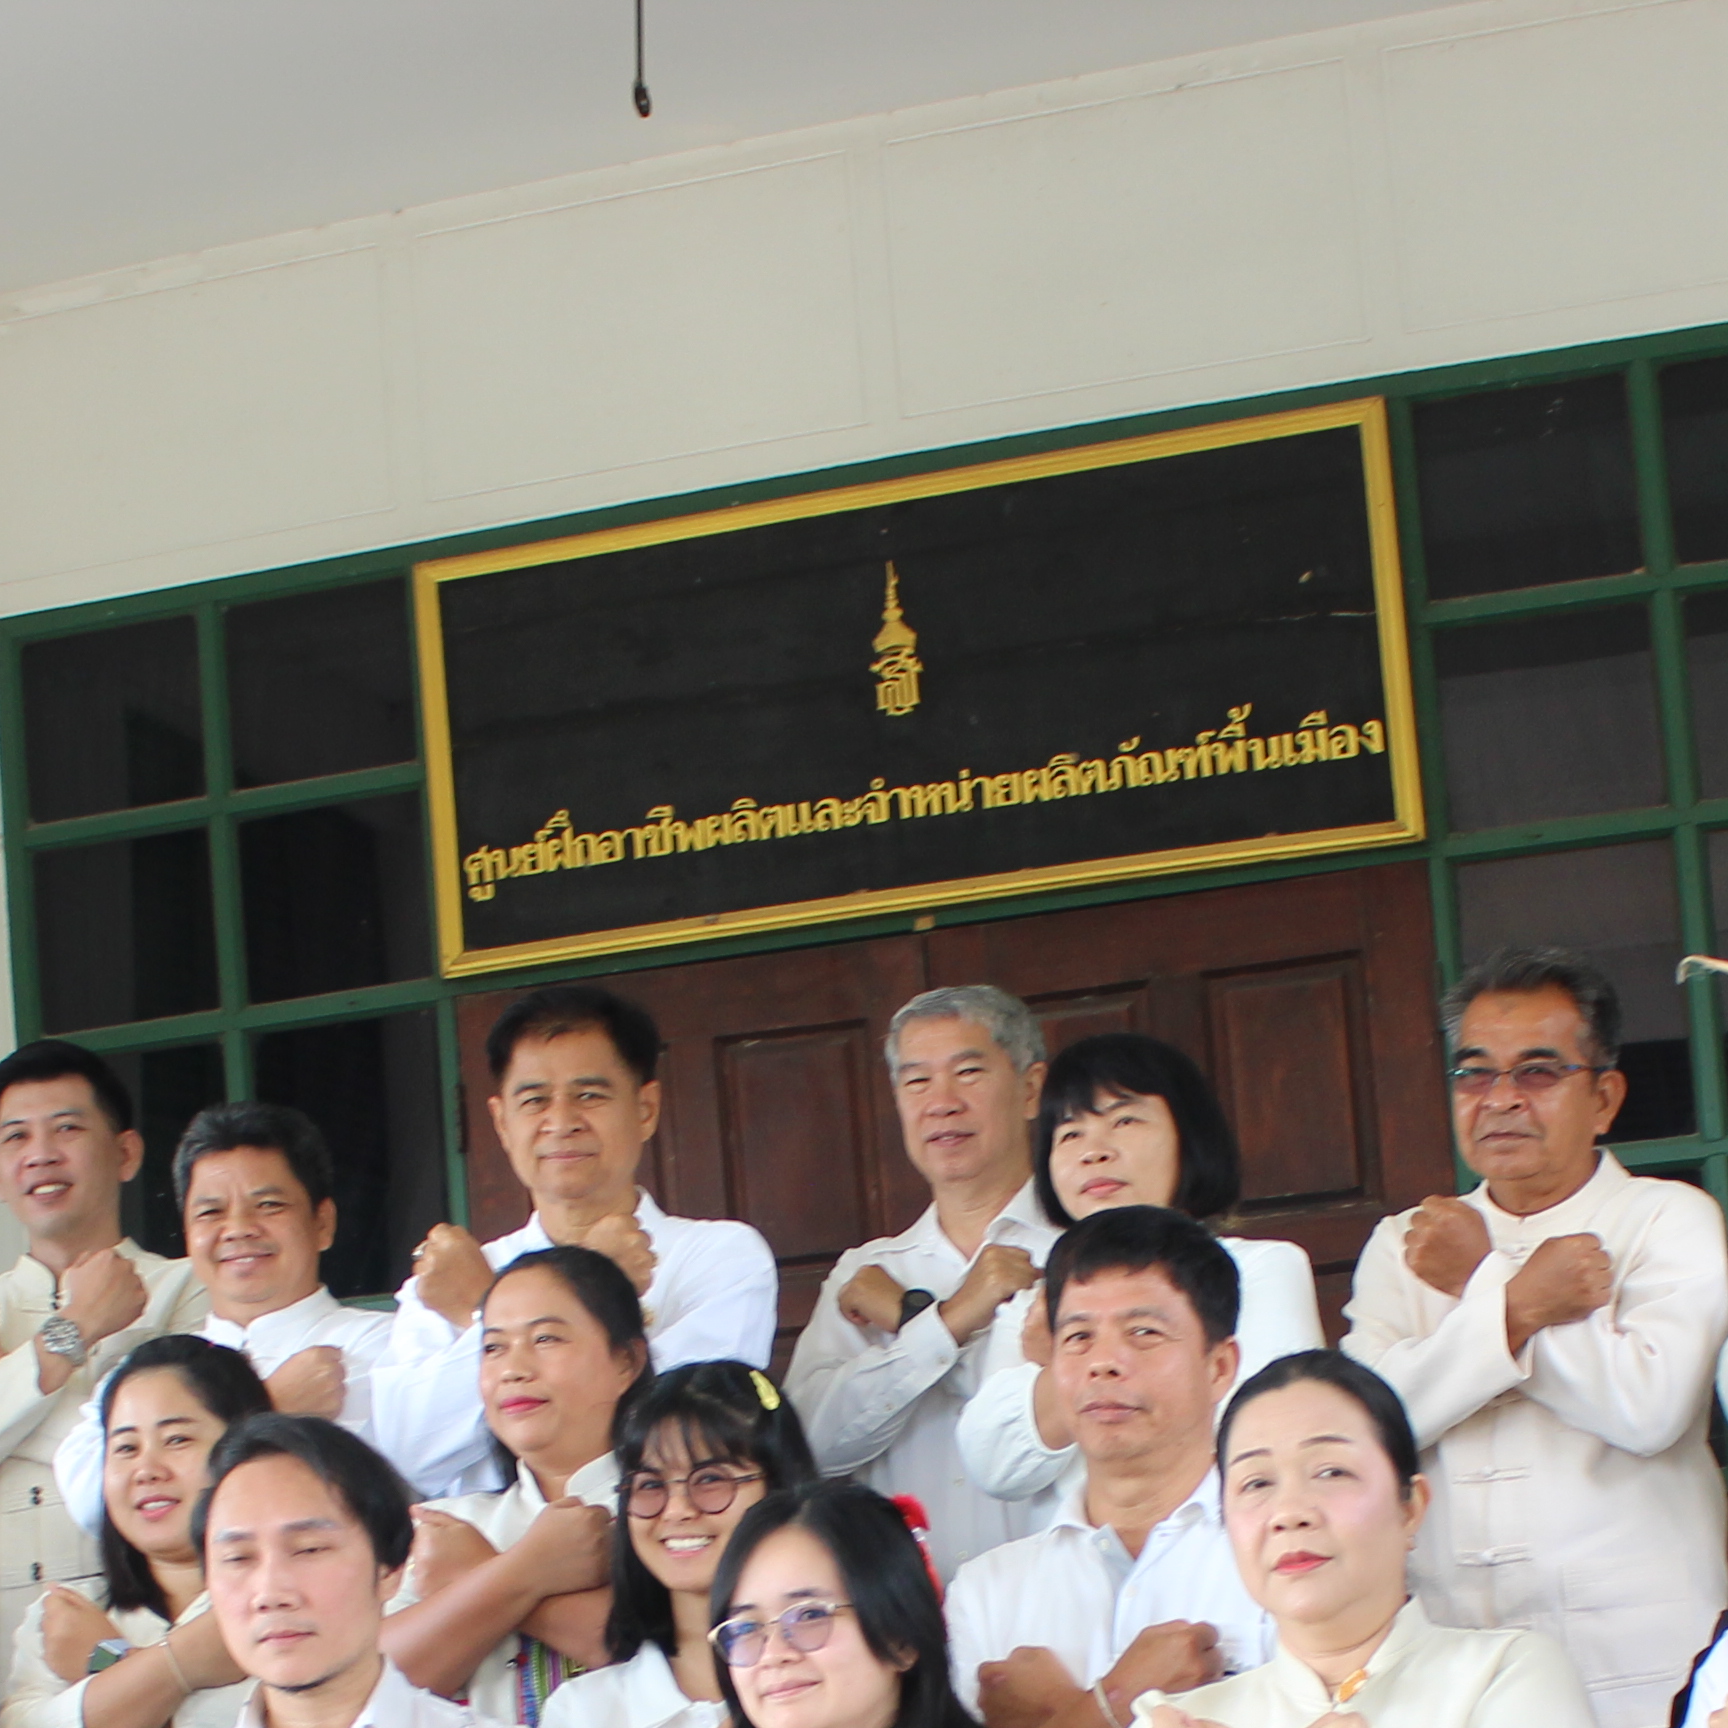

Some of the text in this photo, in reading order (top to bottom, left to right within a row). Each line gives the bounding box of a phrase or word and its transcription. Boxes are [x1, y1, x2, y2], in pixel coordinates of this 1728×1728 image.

[463, 702, 1385, 901] ศูนย์ฝึกอาชีพผลิตและจำหน่ายผลิตภัณฑ์พื้นเมือง
